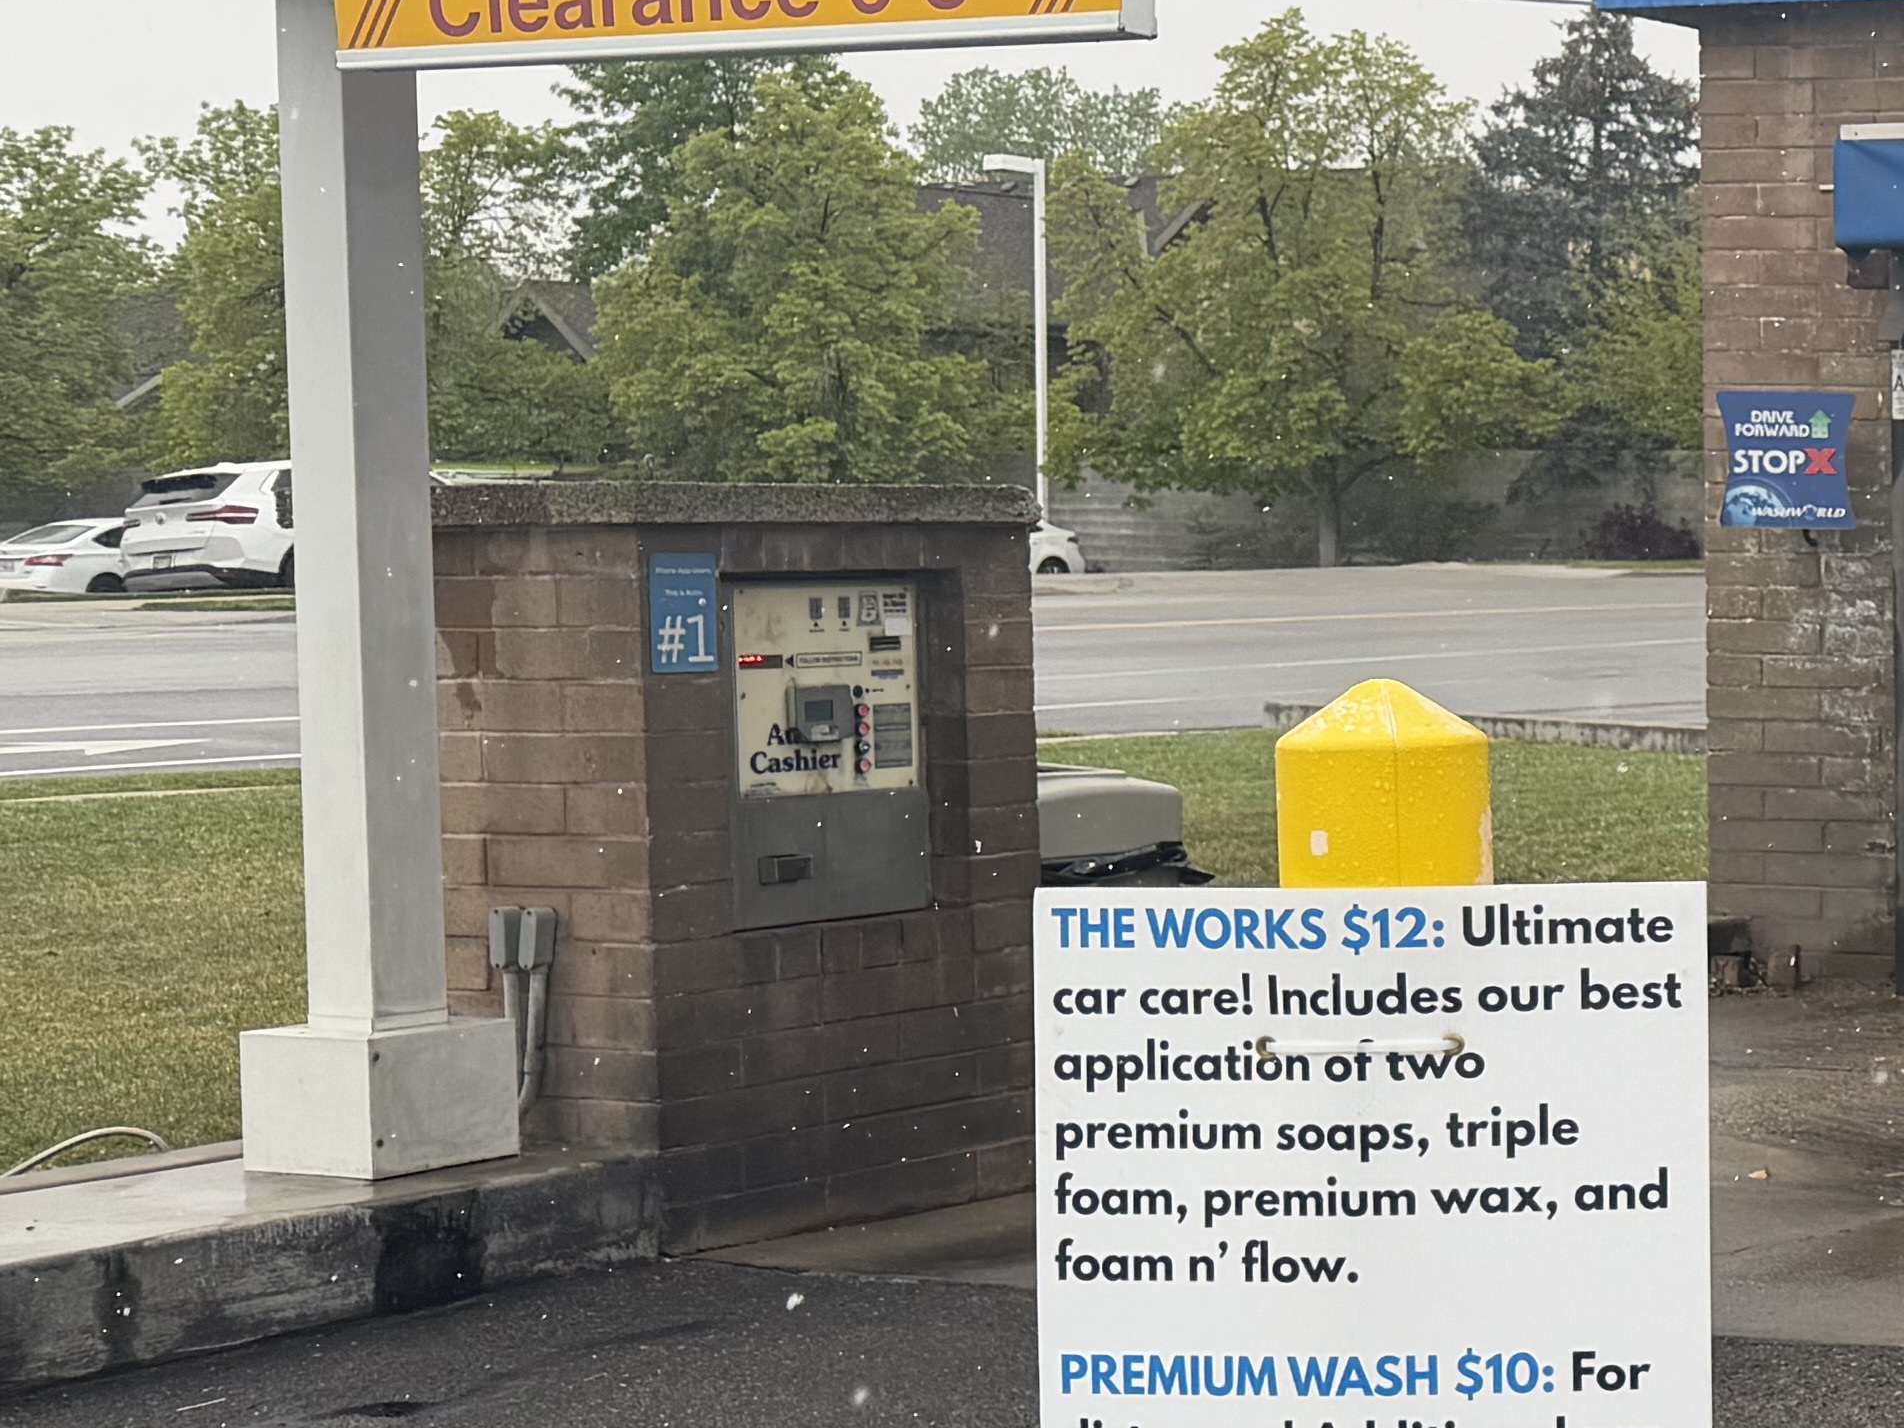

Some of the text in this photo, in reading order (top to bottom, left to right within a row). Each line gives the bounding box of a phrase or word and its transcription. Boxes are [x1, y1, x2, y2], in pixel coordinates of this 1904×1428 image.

[1734, 423, 1810, 438] FORWARD
[1750, 410, 1795, 424] DRIVE
[1733, 449, 1806, 475] STOP
[657, 615, 715, 664] #1
[750, 749, 841, 775] Cashier
[1052, 904, 1673, 955] THE WORKS $12: Ultimate
[1053, 968, 1681, 1016] car care! Includes our best
[1054, 1036, 1309, 1092] application
[1386, 1052, 1485, 1081] two
[1057, 1104, 1578, 1162] premium soaps, triple
[1055, 1167, 1667, 1228] foam, premium wax, and
[1055, 1238, 1172, 1281] foam
[1242, 1240, 1358, 1283] flow.
[1062, 1348, 1650, 1400] PREMIUM WASH $10: For
